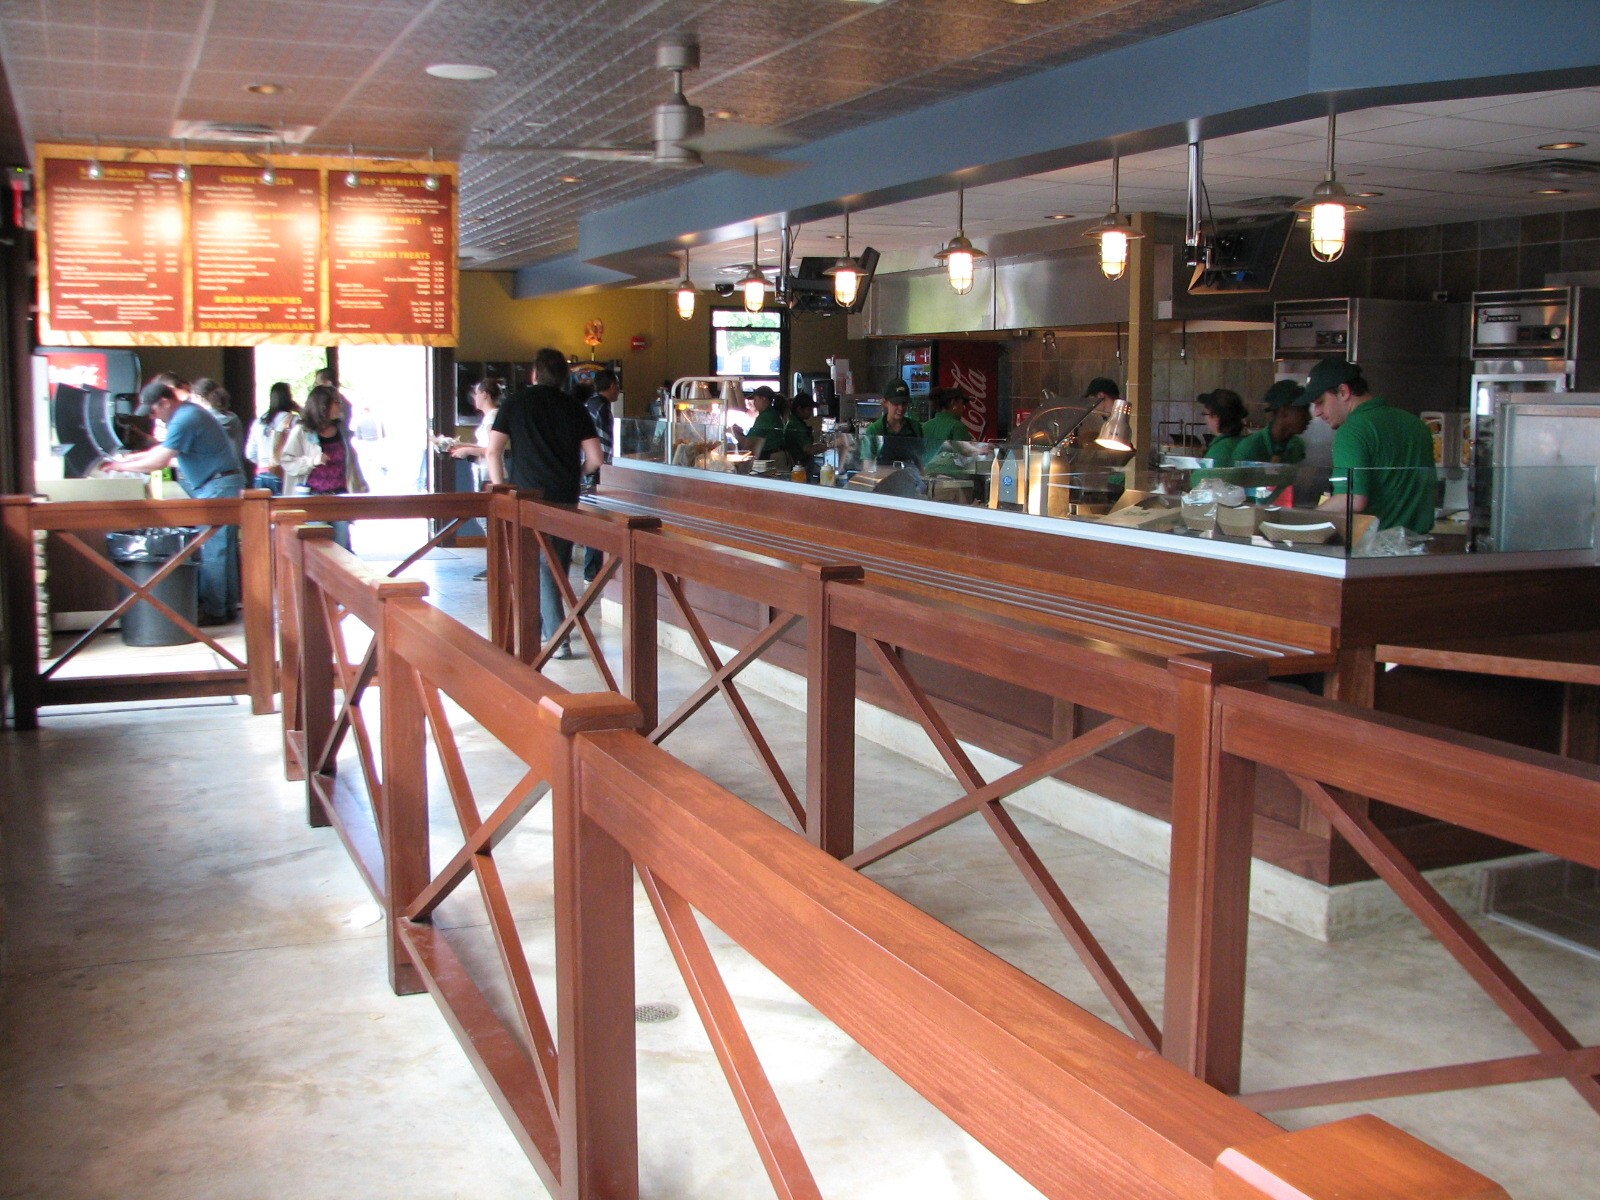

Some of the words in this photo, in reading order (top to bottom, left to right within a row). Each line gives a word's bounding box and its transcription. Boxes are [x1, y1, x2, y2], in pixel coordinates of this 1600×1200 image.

[398, 251, 431, 260] TREATS
[238, 322, 264, 331] ALSO
[264, 322, 316, 332] AVAILABLE
[951, 360, 988, 441] Cola
